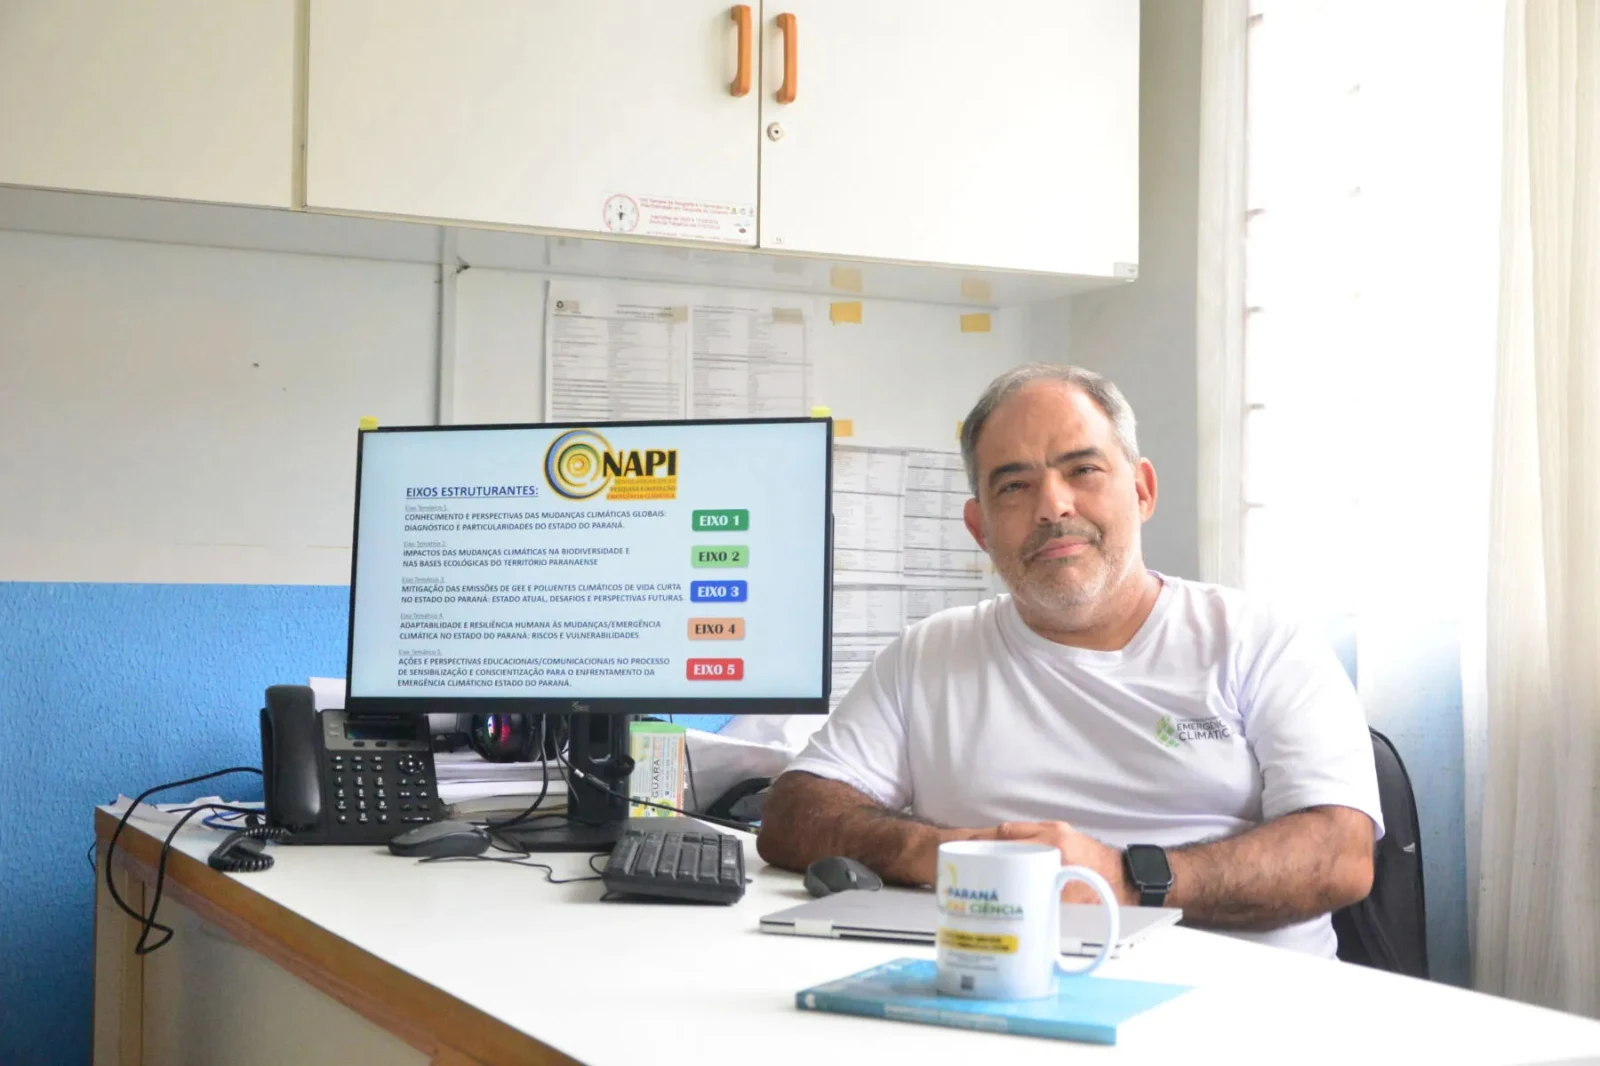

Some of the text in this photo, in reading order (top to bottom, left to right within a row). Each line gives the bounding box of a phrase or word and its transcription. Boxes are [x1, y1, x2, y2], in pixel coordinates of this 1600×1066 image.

[603, 450, 676, 477] NAPI
[406, 485, 539, 498] EIXOS ESTRUTURANTES:
[405, 513, 464, 521] CONHECIMENTO
[472, 512, 523, 520] PERSPECTIVAS
[525, 512, 539, 520] DAS
[542, 512, 584, 521] MUDANÇAS
[587, 510, 630, 519] CLIMÁTICAS
[699, 515, 740, 527] EIXO 1
[405, 523, 454, 532] DIAGNÓSTICO
[462, 523, 533, 531] PARTICULARIDADES
[535, 523, 546, 531] DO
[548, 523, 576, 531] ESTADO
[459, 549, 501, 557] MUDANÇAS
[504, 547, 546, 555] CLIMÁTICAS
[698, 551, 740, 563] EIXO 2
[443, 558, 488, 566] ECOLÓGICAS
[504, 558, 547, 566] TERRITÓRIO
[402, 584, 443, 594] MITIGAÇÃO
[462, 584, 498, 592] EMISSÕES
[534, 584, 576, 592] POLUENTES
[578, 583, 622, 592] CLIMÁTICOS
[625, 584, 633, 592] DE
[697, 586, 739, 598] EIXO 3
[470, 620, 513, 628] RESILIÊNCIA
[564, 620, 660, 629] MUDANÇAS/EMERGÊNCIA
[695, 624, 735, 635] EIXO 4
[400, 631, 438, 639] CLIMÁTICA
[399, 657, 422, 666] AÇÕES
[410, 667, 467, 677] SENSIBILIZAÇÃO
[476, 668, 544, 677] CONSCIENTIZAÇÃO
[693, 664, 735, 676] EIXO 5
[398, 678, 445, 686] EMERGÊNCIA
